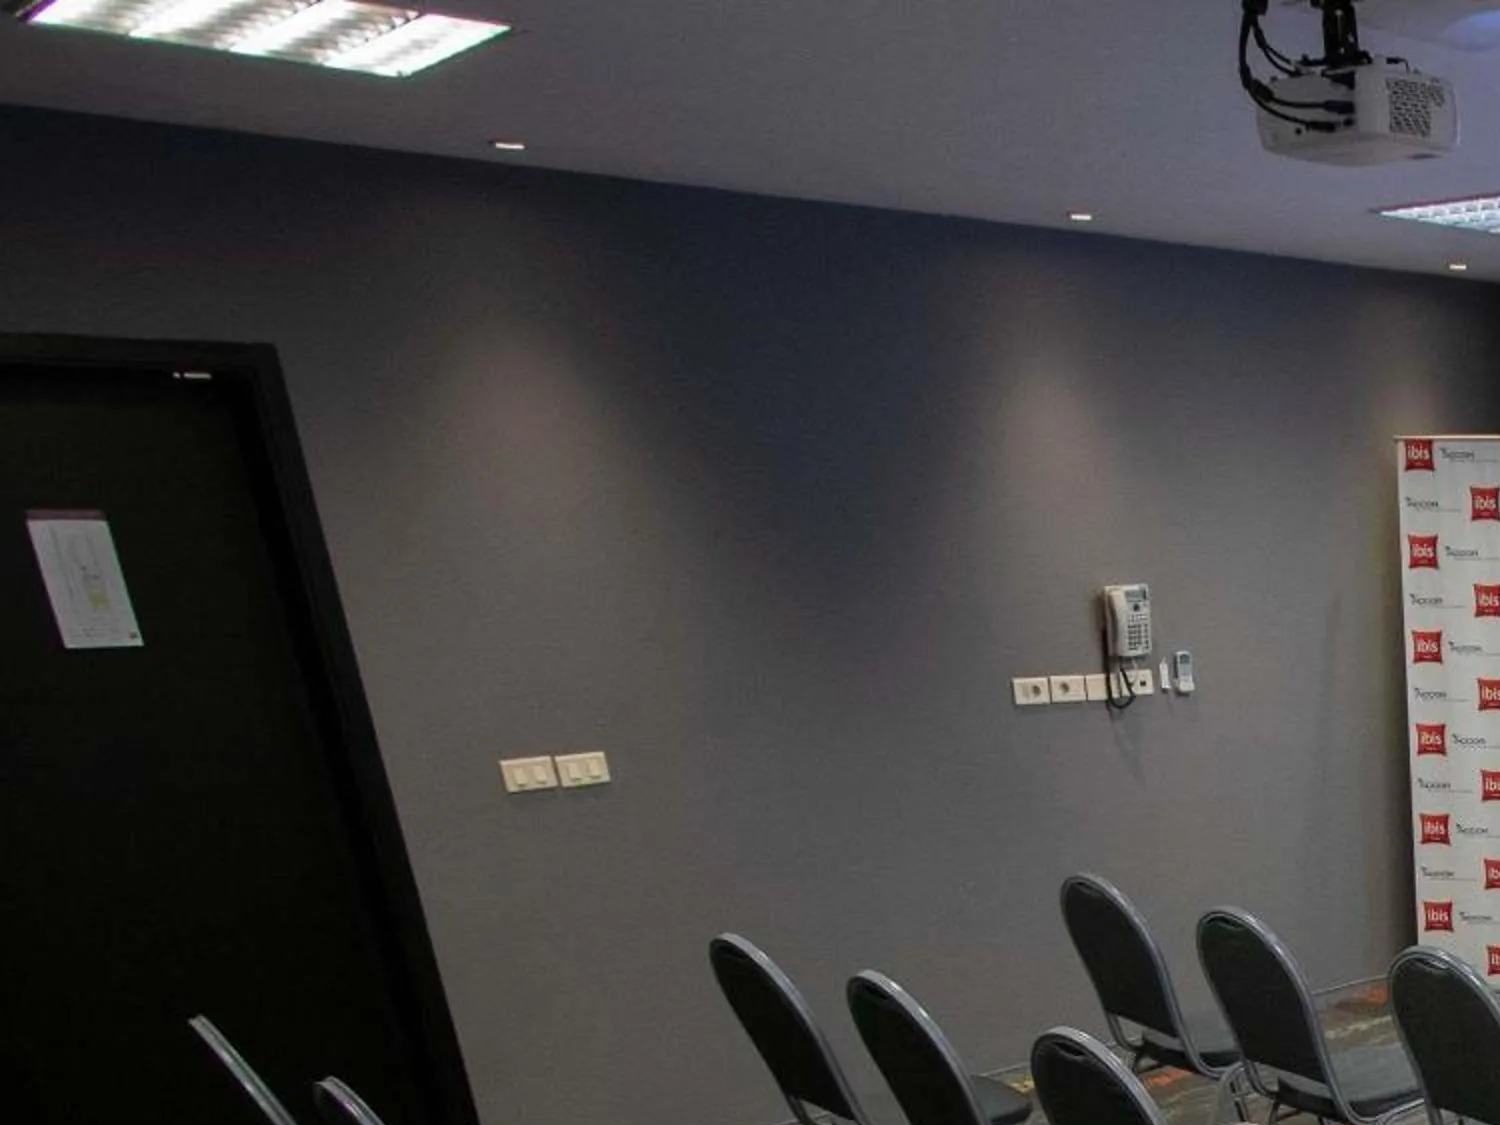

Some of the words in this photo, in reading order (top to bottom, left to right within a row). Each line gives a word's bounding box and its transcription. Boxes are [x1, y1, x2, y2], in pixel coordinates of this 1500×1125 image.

[1407, 445, 1429, 460] ibis
[1412, 543, 1434, 557] ibis
[1417, 639, 1438, 653] ibis
[1420, 731, 1441, 745] ibis
[1425, 821, 1445, 835] ibis
[1427, 908, 1449, 921] ibis
